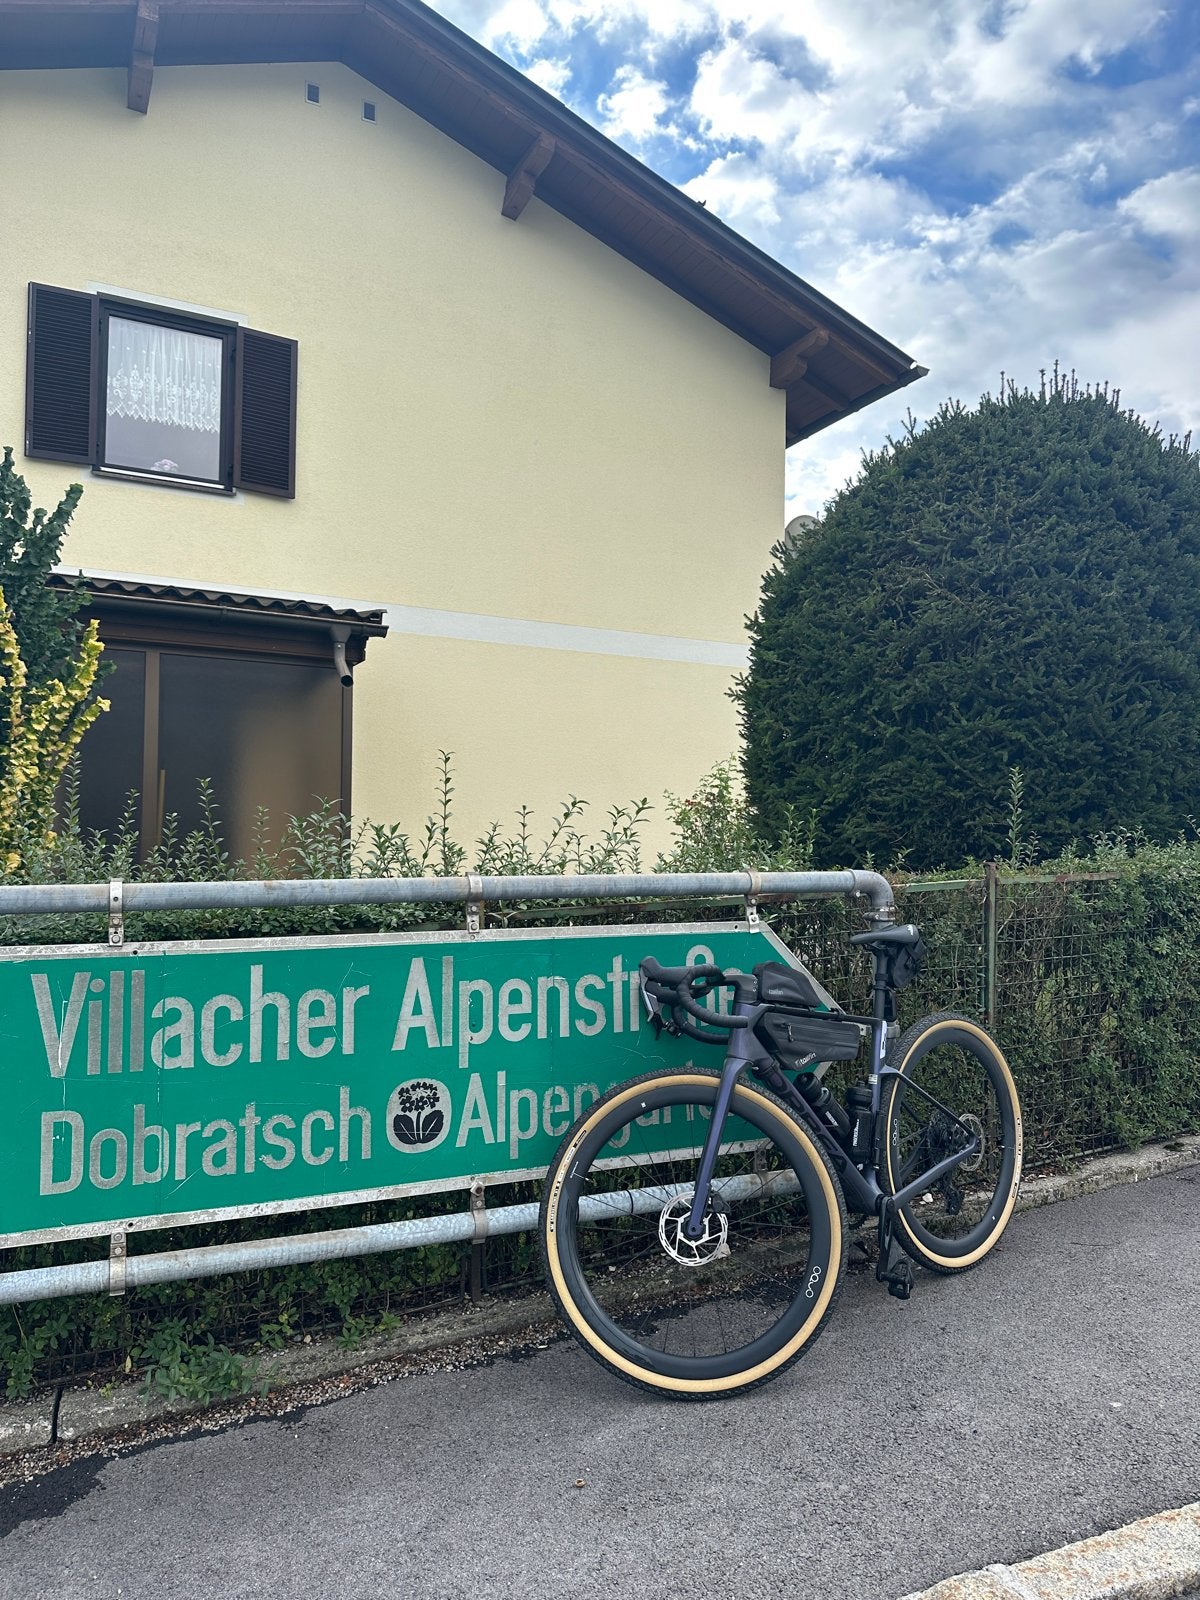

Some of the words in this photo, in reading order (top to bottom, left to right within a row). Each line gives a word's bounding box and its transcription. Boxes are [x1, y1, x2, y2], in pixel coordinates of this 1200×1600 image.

[30, 964, 370, 1078] Villacher
[391, 945, 745, 1069] Alpenstrß
[39, 1086, 372, 1196] Dobratsch
